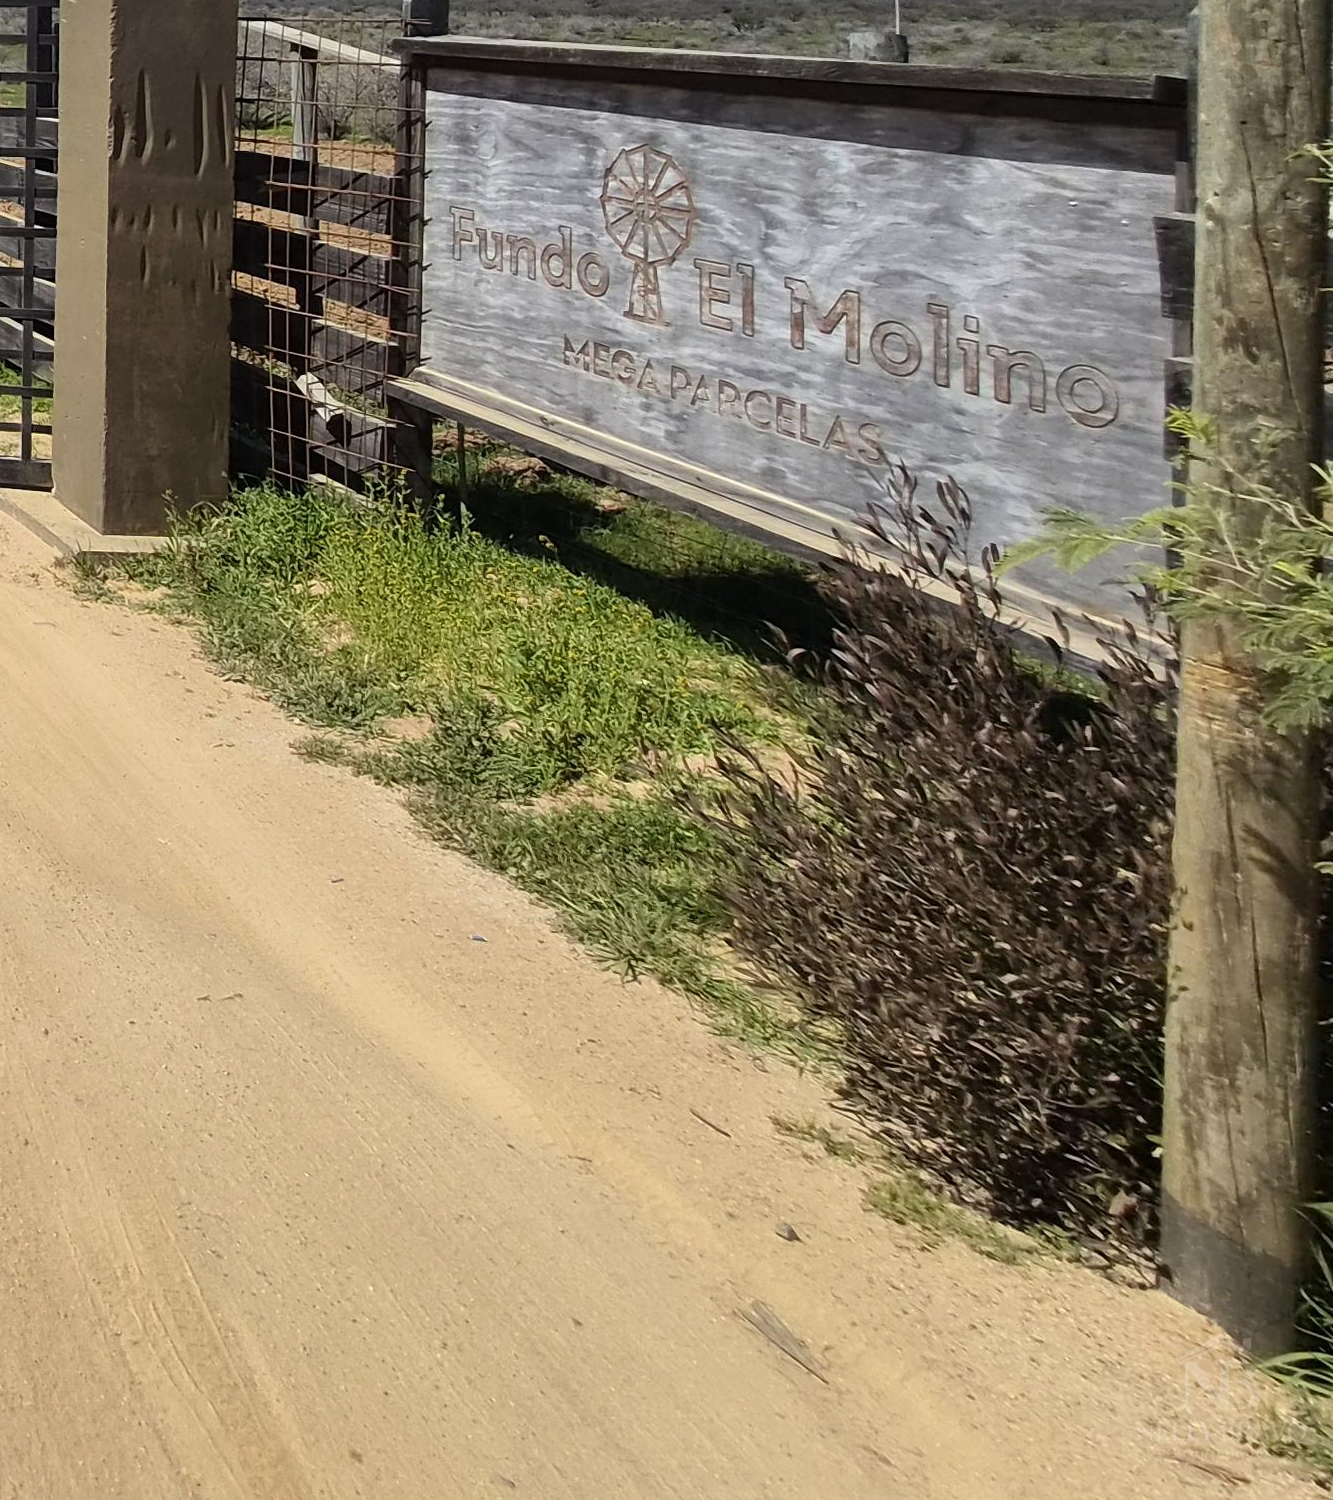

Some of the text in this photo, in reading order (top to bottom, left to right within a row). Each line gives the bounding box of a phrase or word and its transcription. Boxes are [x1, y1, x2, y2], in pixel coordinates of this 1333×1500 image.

[449, 205, 1122, 429] Fundo El Molino
[563, 333, 884, 465] MEGA PARCELAS
